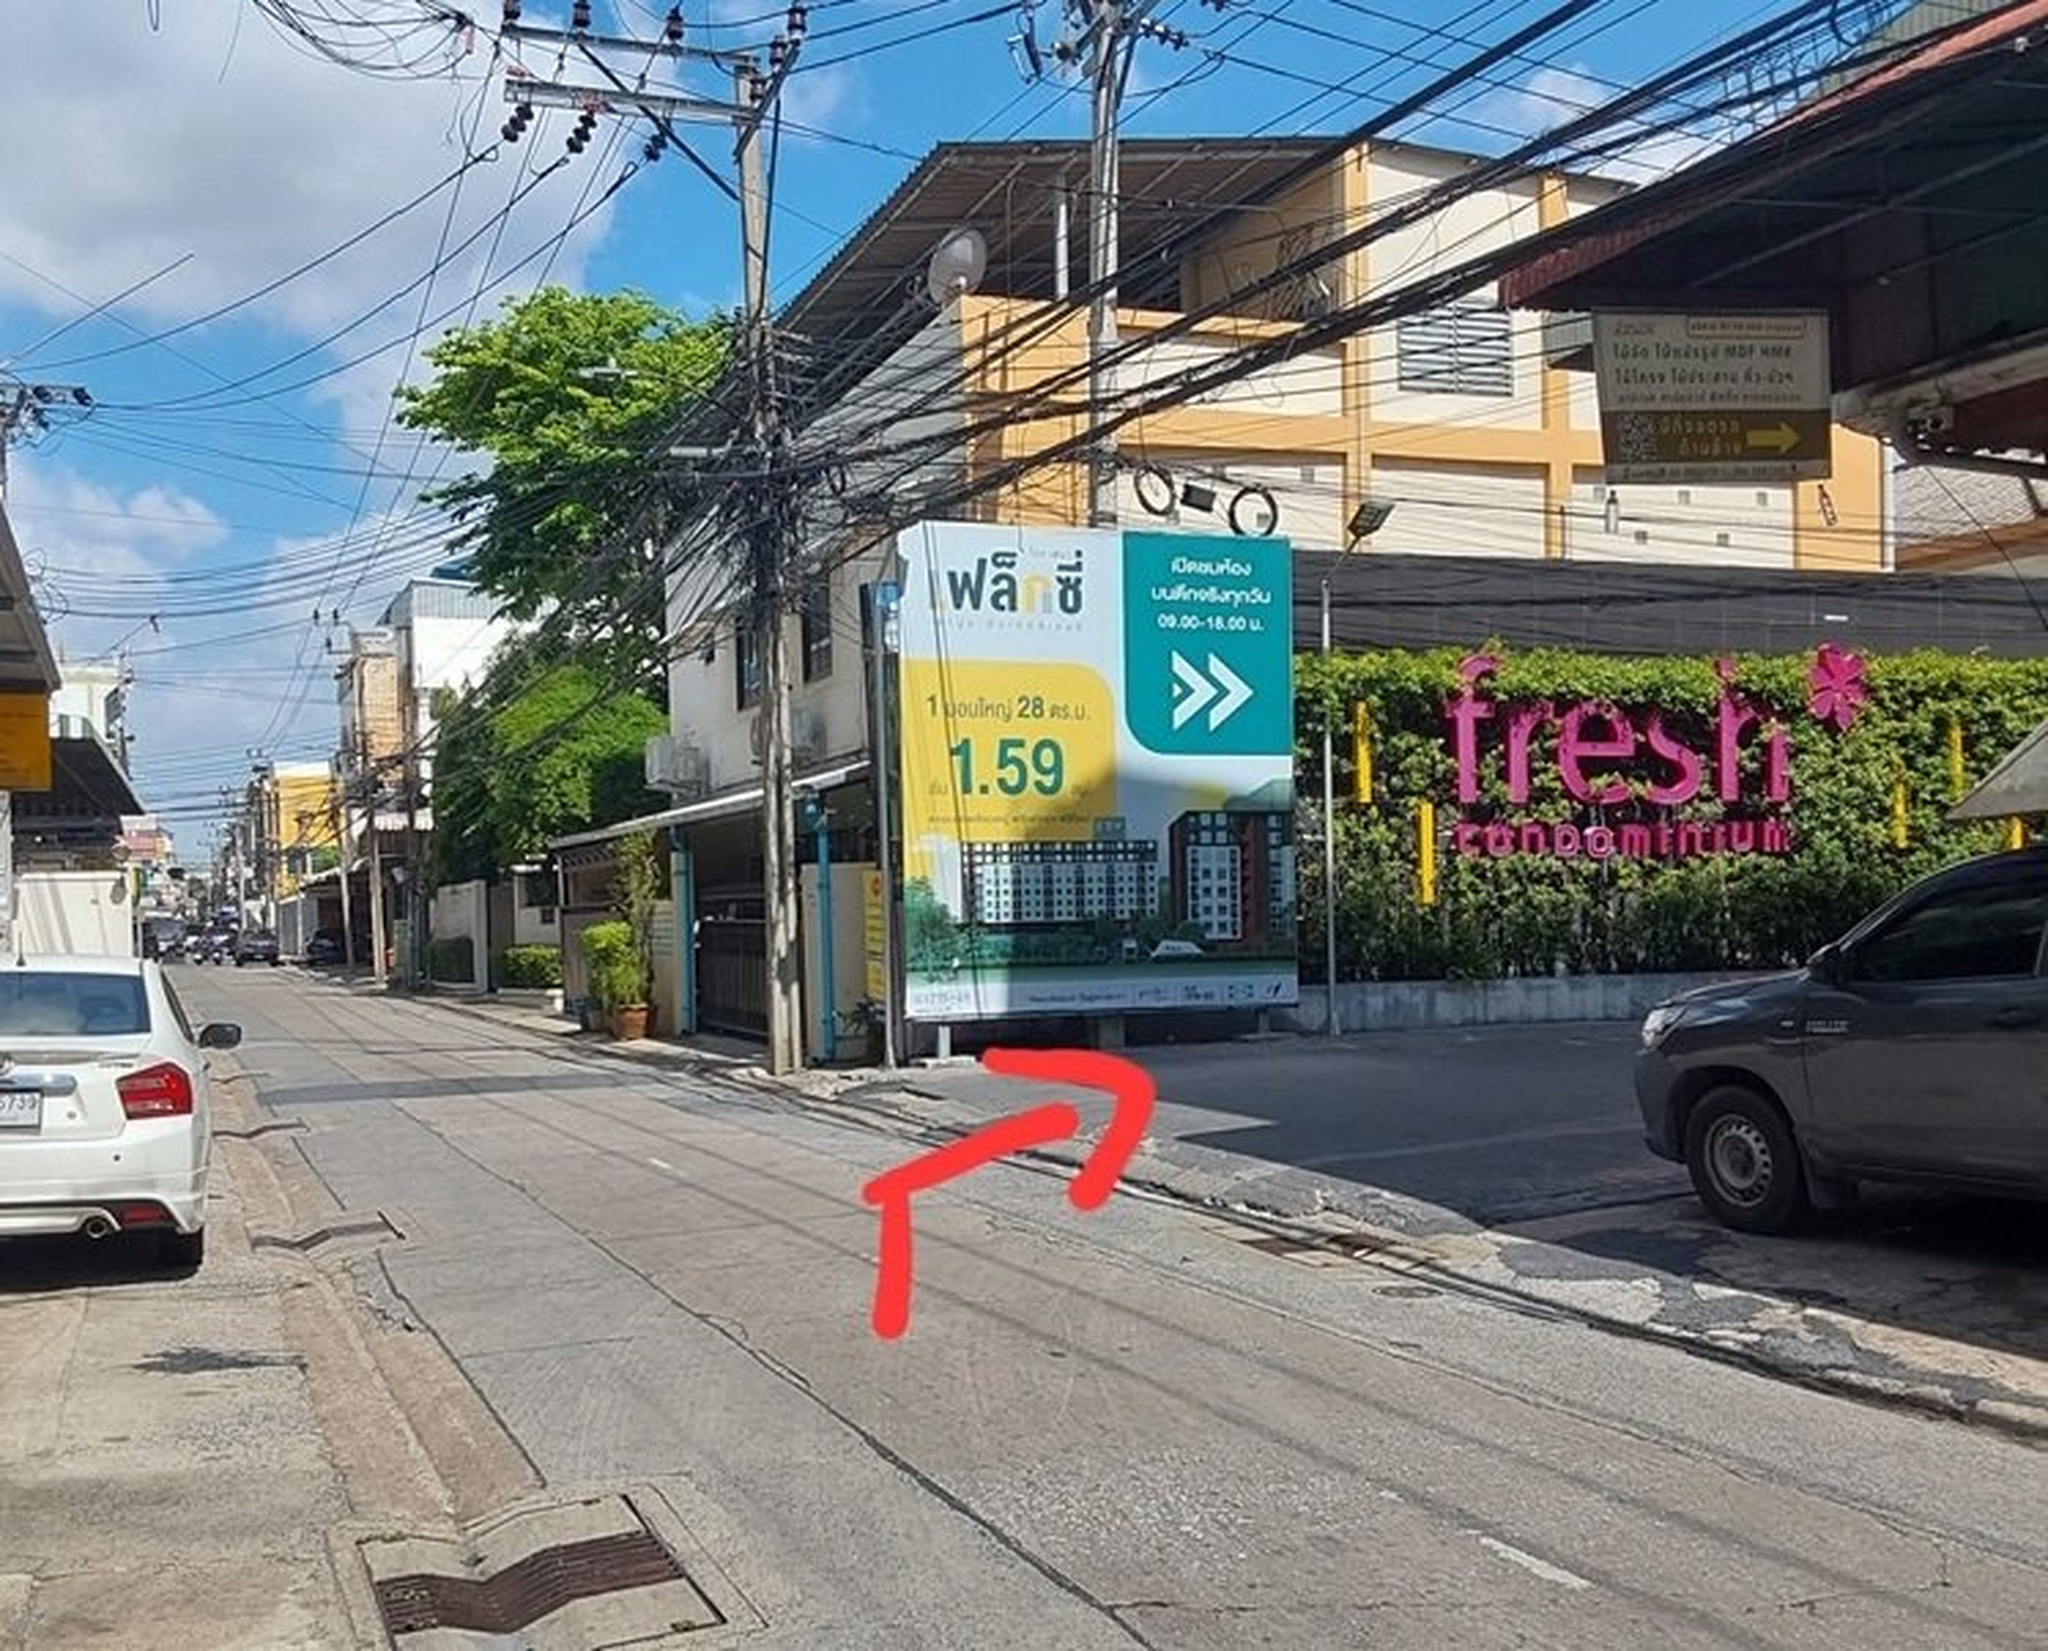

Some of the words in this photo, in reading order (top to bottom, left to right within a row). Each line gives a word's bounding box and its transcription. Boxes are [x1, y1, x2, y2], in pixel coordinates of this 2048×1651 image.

[1723, 343, 1754, 360] MDF
[1172, 557, 1251, 576] เปิดชมห้อง
[1152, 584, 1271, 608] บนตึกจริงทุกวัน
[1157, 613, 1246, 631] 09.00-18.00
[927, 695, 938, 717] 1
[1017, 695, 1045, 719] 28
[1049, 703, 1092, 720] ตร.ม.
[1446, 654, 1791, 805] fresh
[950, 738, 1064, 795] 1.59
